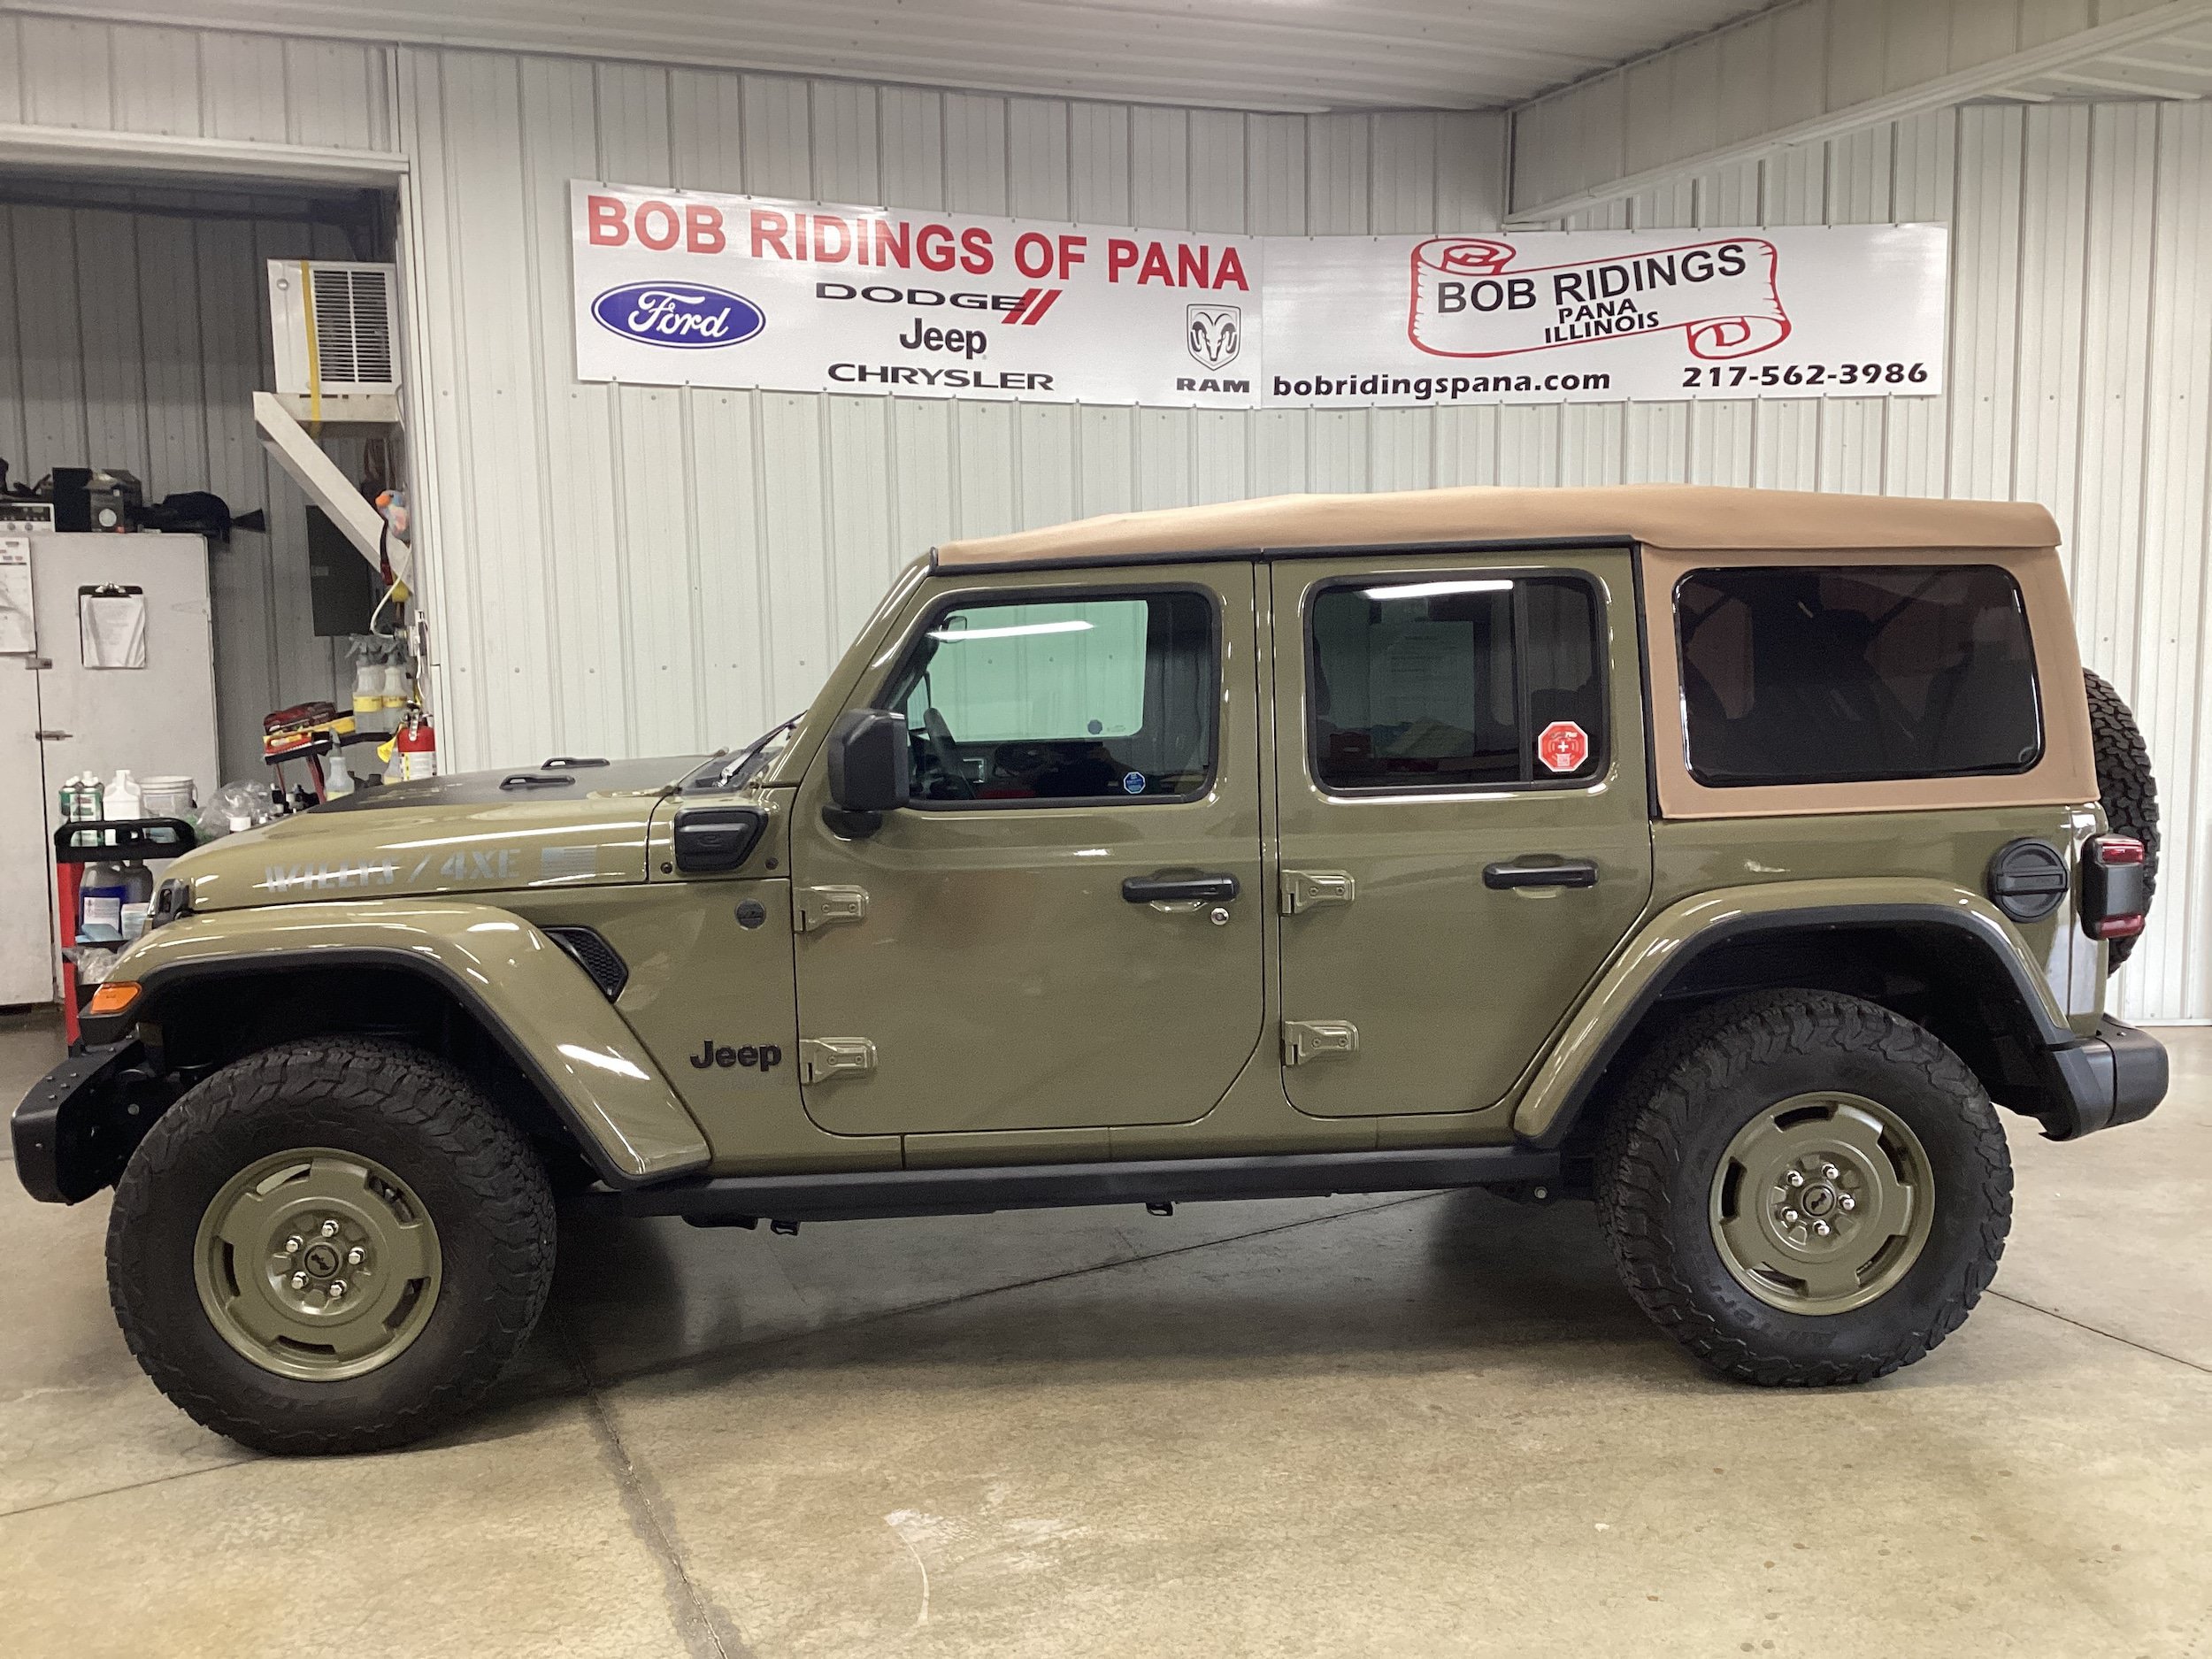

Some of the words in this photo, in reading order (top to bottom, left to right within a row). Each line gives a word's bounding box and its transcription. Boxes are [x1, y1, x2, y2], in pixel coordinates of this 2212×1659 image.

[587, 194, 727, 255] BOB
[750, 209, 995, 276] RIDINGS
[1014, 231, 1087, 280] OF
[1106, 237, 1250, 292] PANA
[1438, 277, 1537, 313] BOB
[1553, 243, 1746, 306] RIDINGS
[816, 282, 1026, 312] DODGE
[1558, 297, 1638, 324] PANA
[627, 290, 732, 338] Ford
[1544, 311, 1660, 344] ILLINOIS
[899, 317, 987, 360] Jeep
[828, 363, 1054, 390] CHRYSLER
[1176, 377, 1250, 393] RAM
[1273, 372, 1610, 400] bobridingspana.com
[1682, 362, 1929, 388] 217-562-3986
[440, 848, 520, 880] 4XE
[689, 1038, 782, 1072] Jeep
